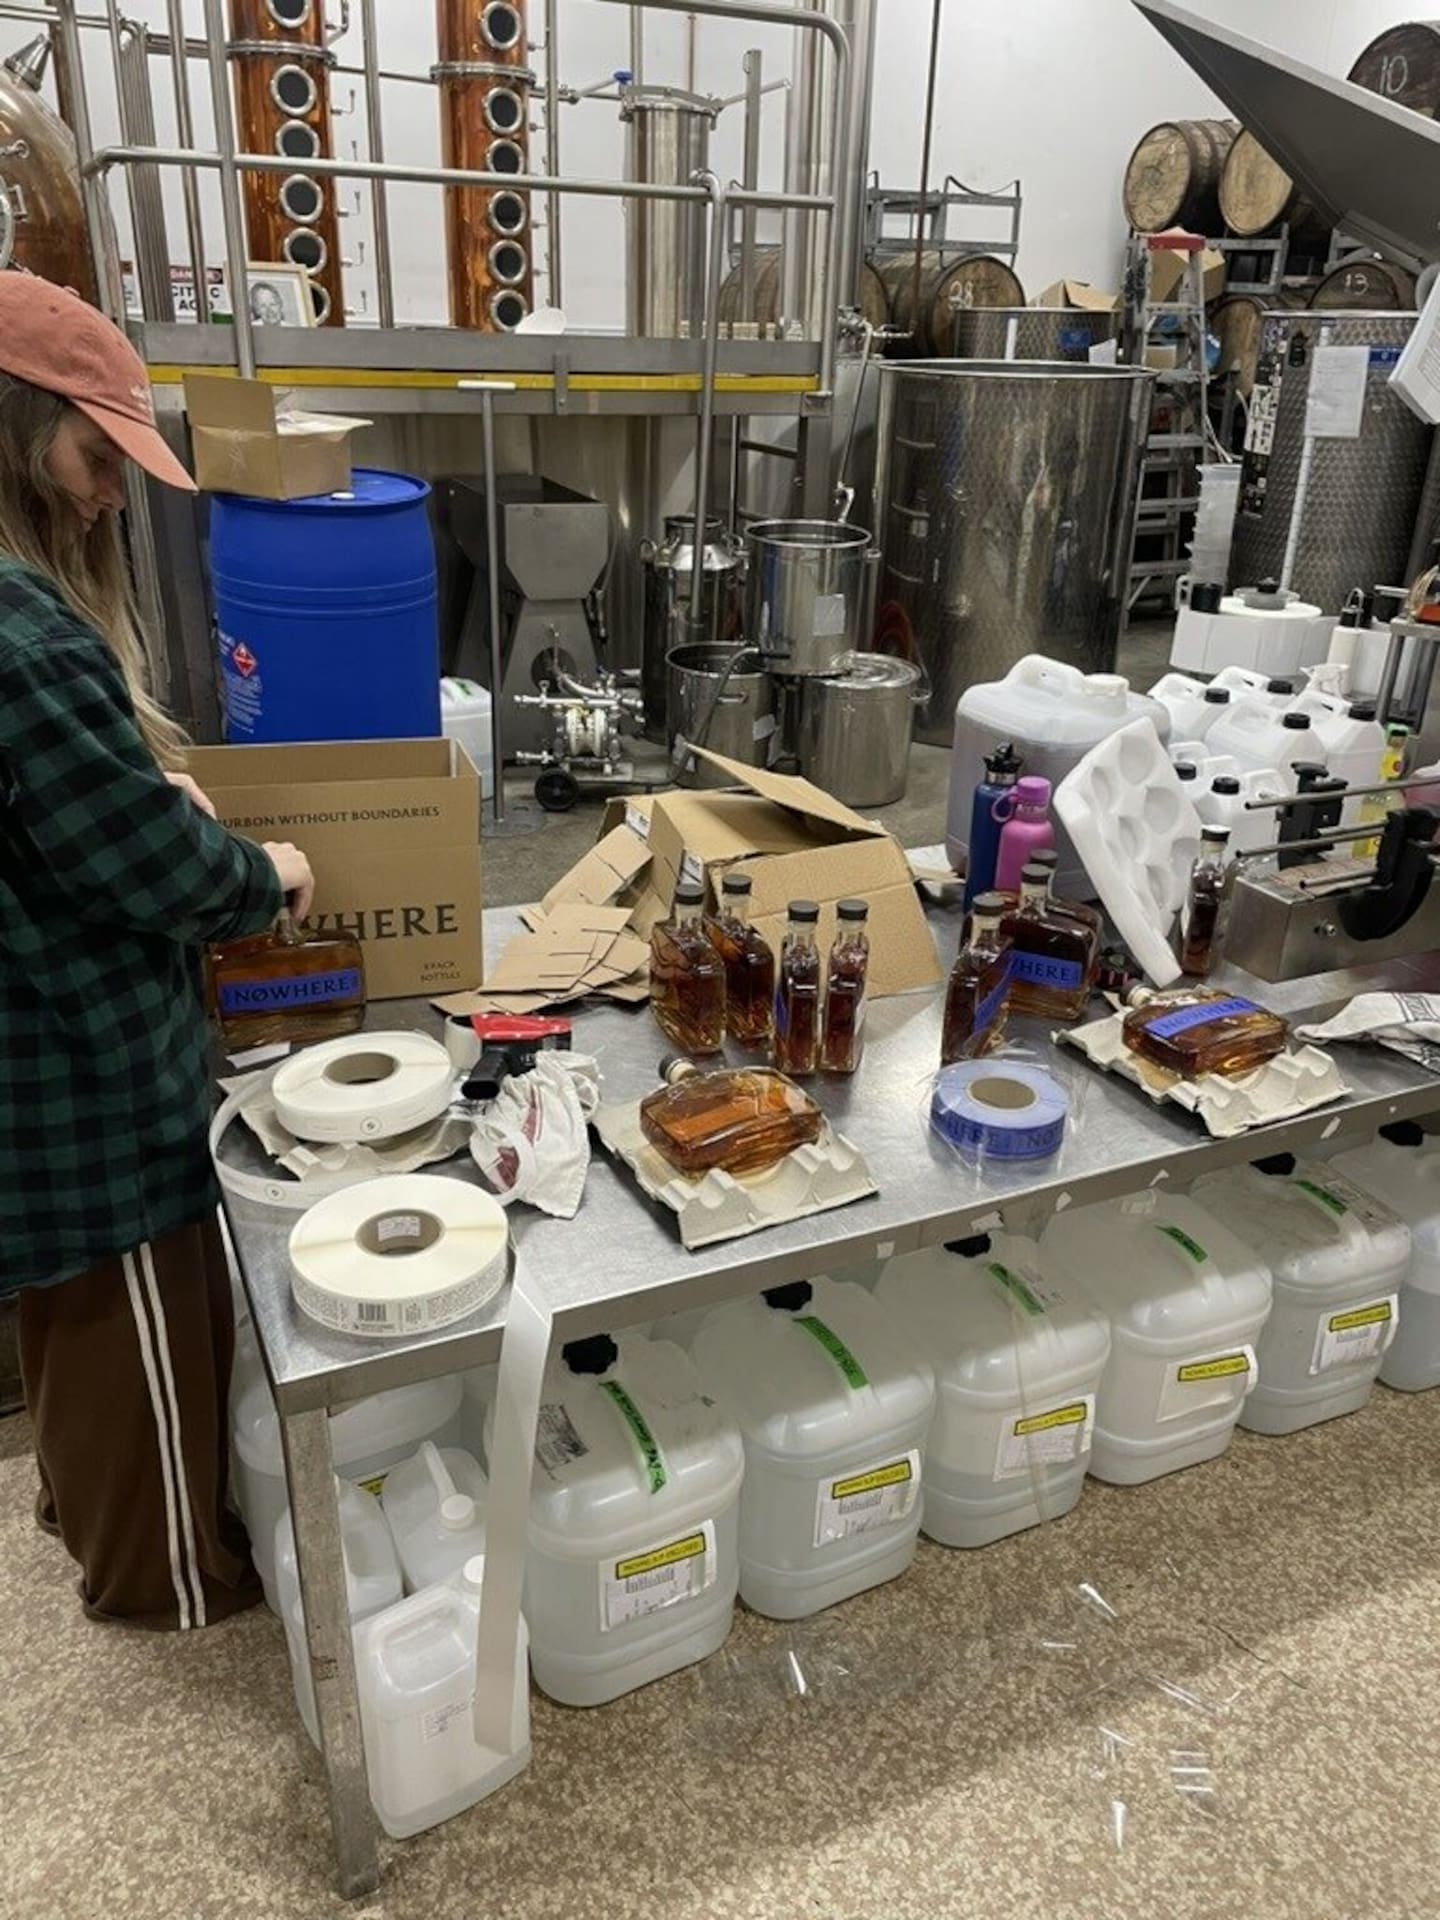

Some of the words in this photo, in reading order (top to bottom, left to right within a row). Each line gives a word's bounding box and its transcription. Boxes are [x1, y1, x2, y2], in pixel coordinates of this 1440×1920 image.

[1380, 55, 1408, 94] 10
[171, 285, 220, 299] CITC
[1345, 272, 1370, 296] 13
[217, 816, 275, 829] URBON
[277, 812, 350, 826] WITHOUT
[352, 806, 440, 821] BOUNDARIES
[299, 903, 459, 940] WHERE
[1011, 959, 1071, 981] HERE
